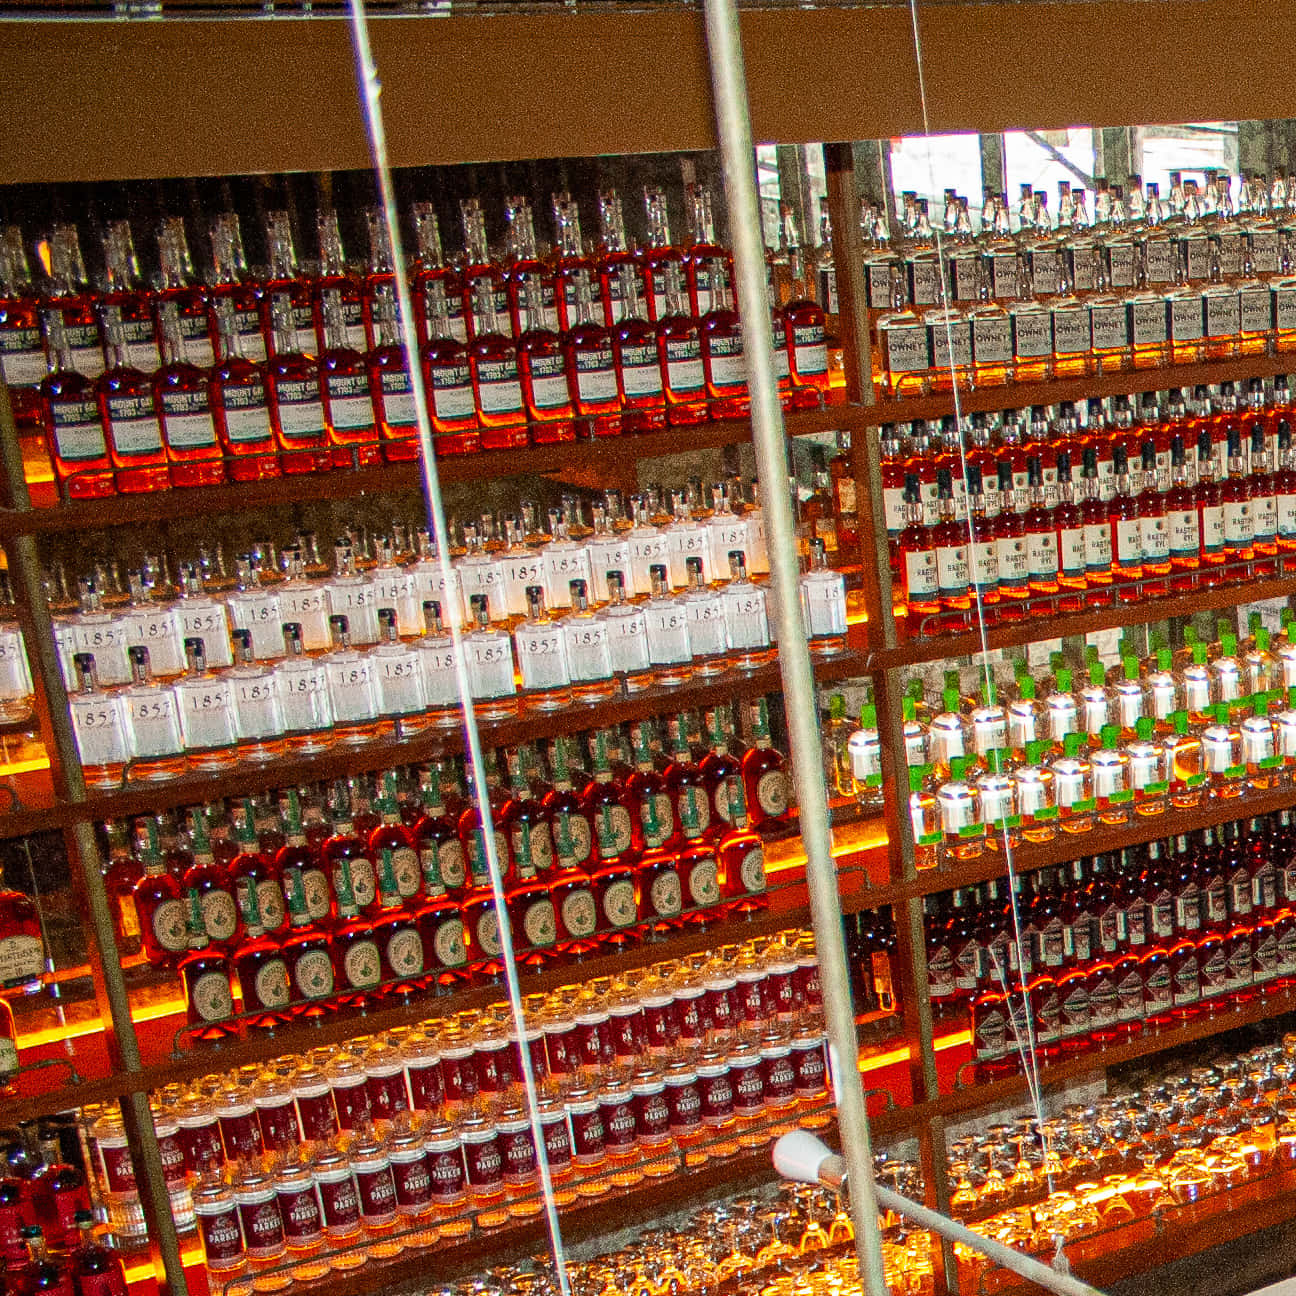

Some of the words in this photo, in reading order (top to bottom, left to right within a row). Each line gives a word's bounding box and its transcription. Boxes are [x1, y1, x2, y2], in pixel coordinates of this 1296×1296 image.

[976, 333, 1007, 342] OWNEY
[1017, 328, 1048, 338] OWNEY
[889, 342, 924, 352] OWNEY
[432, 1167, 461, 1180] PARKER
[209, 1228, 239, 1244] PARKER
